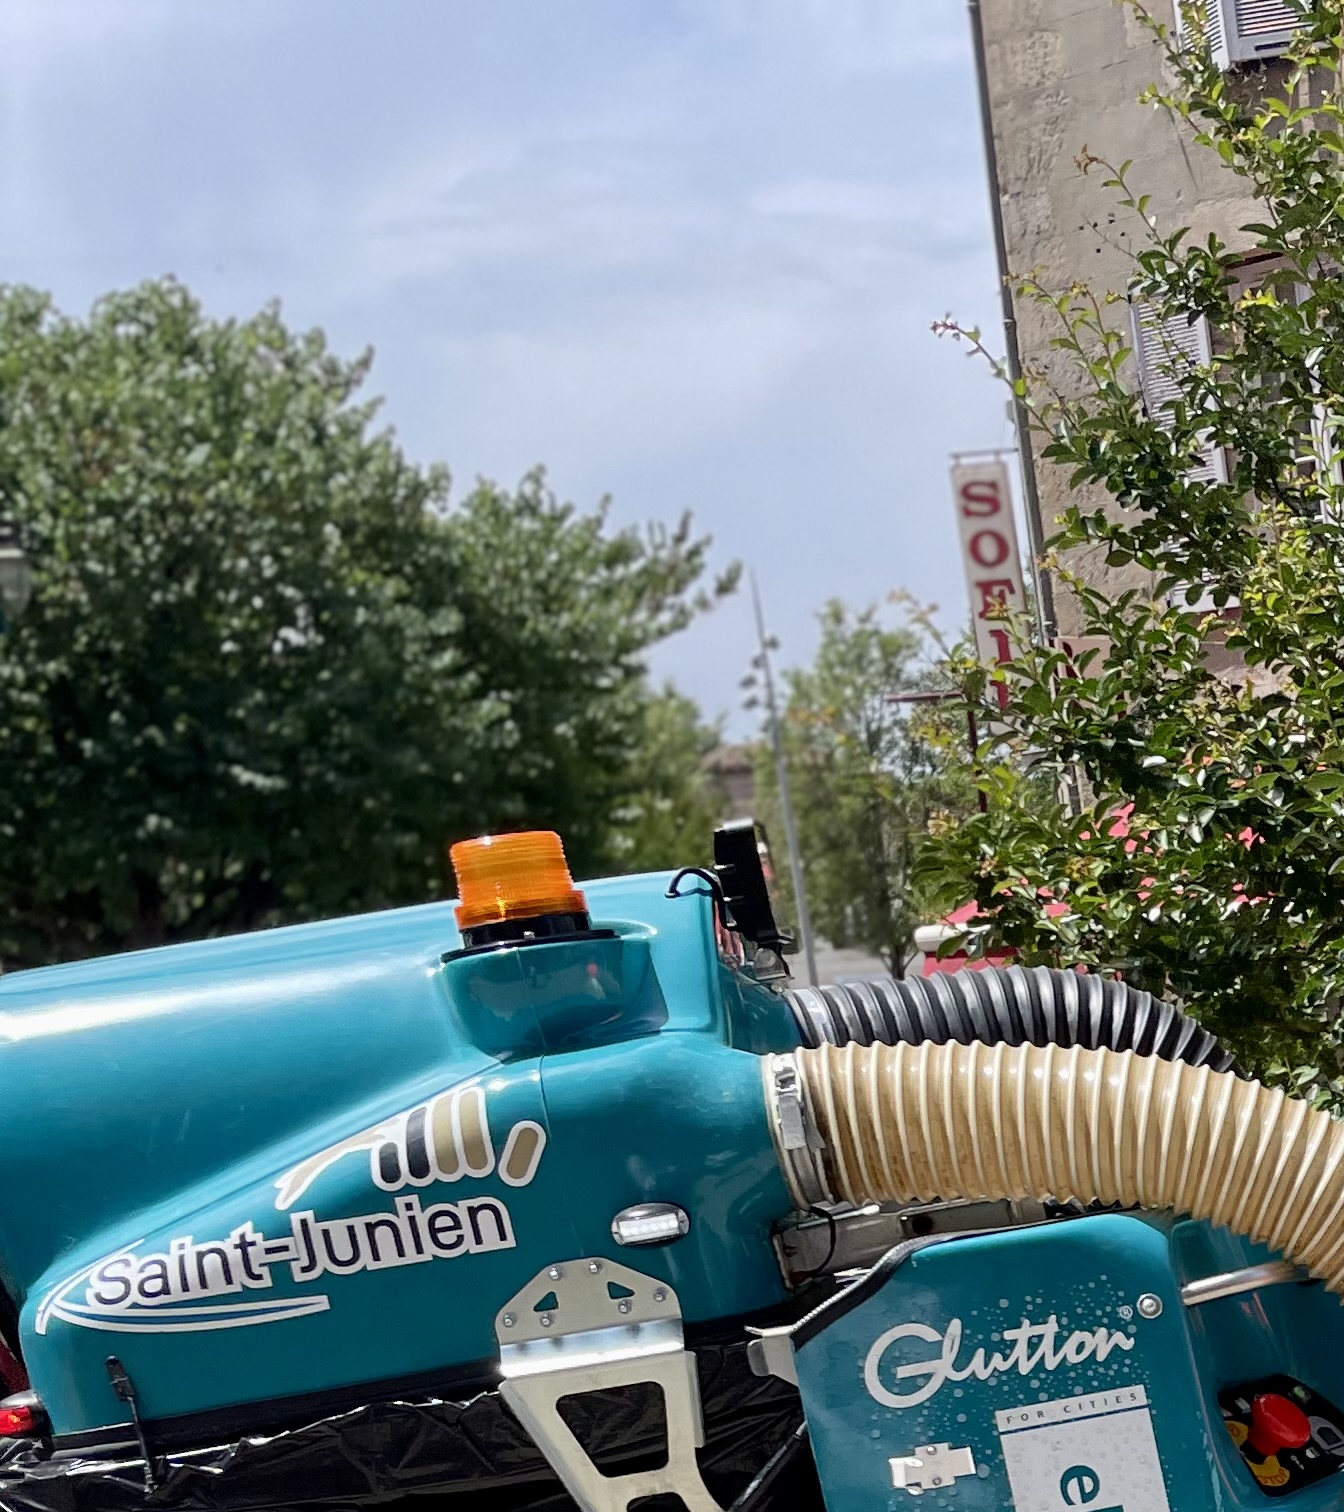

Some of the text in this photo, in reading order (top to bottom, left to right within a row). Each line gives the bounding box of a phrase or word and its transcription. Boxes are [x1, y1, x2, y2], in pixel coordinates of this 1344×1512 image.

[92, 1196, 510, 1307] Saint-Junien
[864, 1312, 1136, 1409] Glutton
[1006, 1391, 1139, 1425] FOR CITIES
